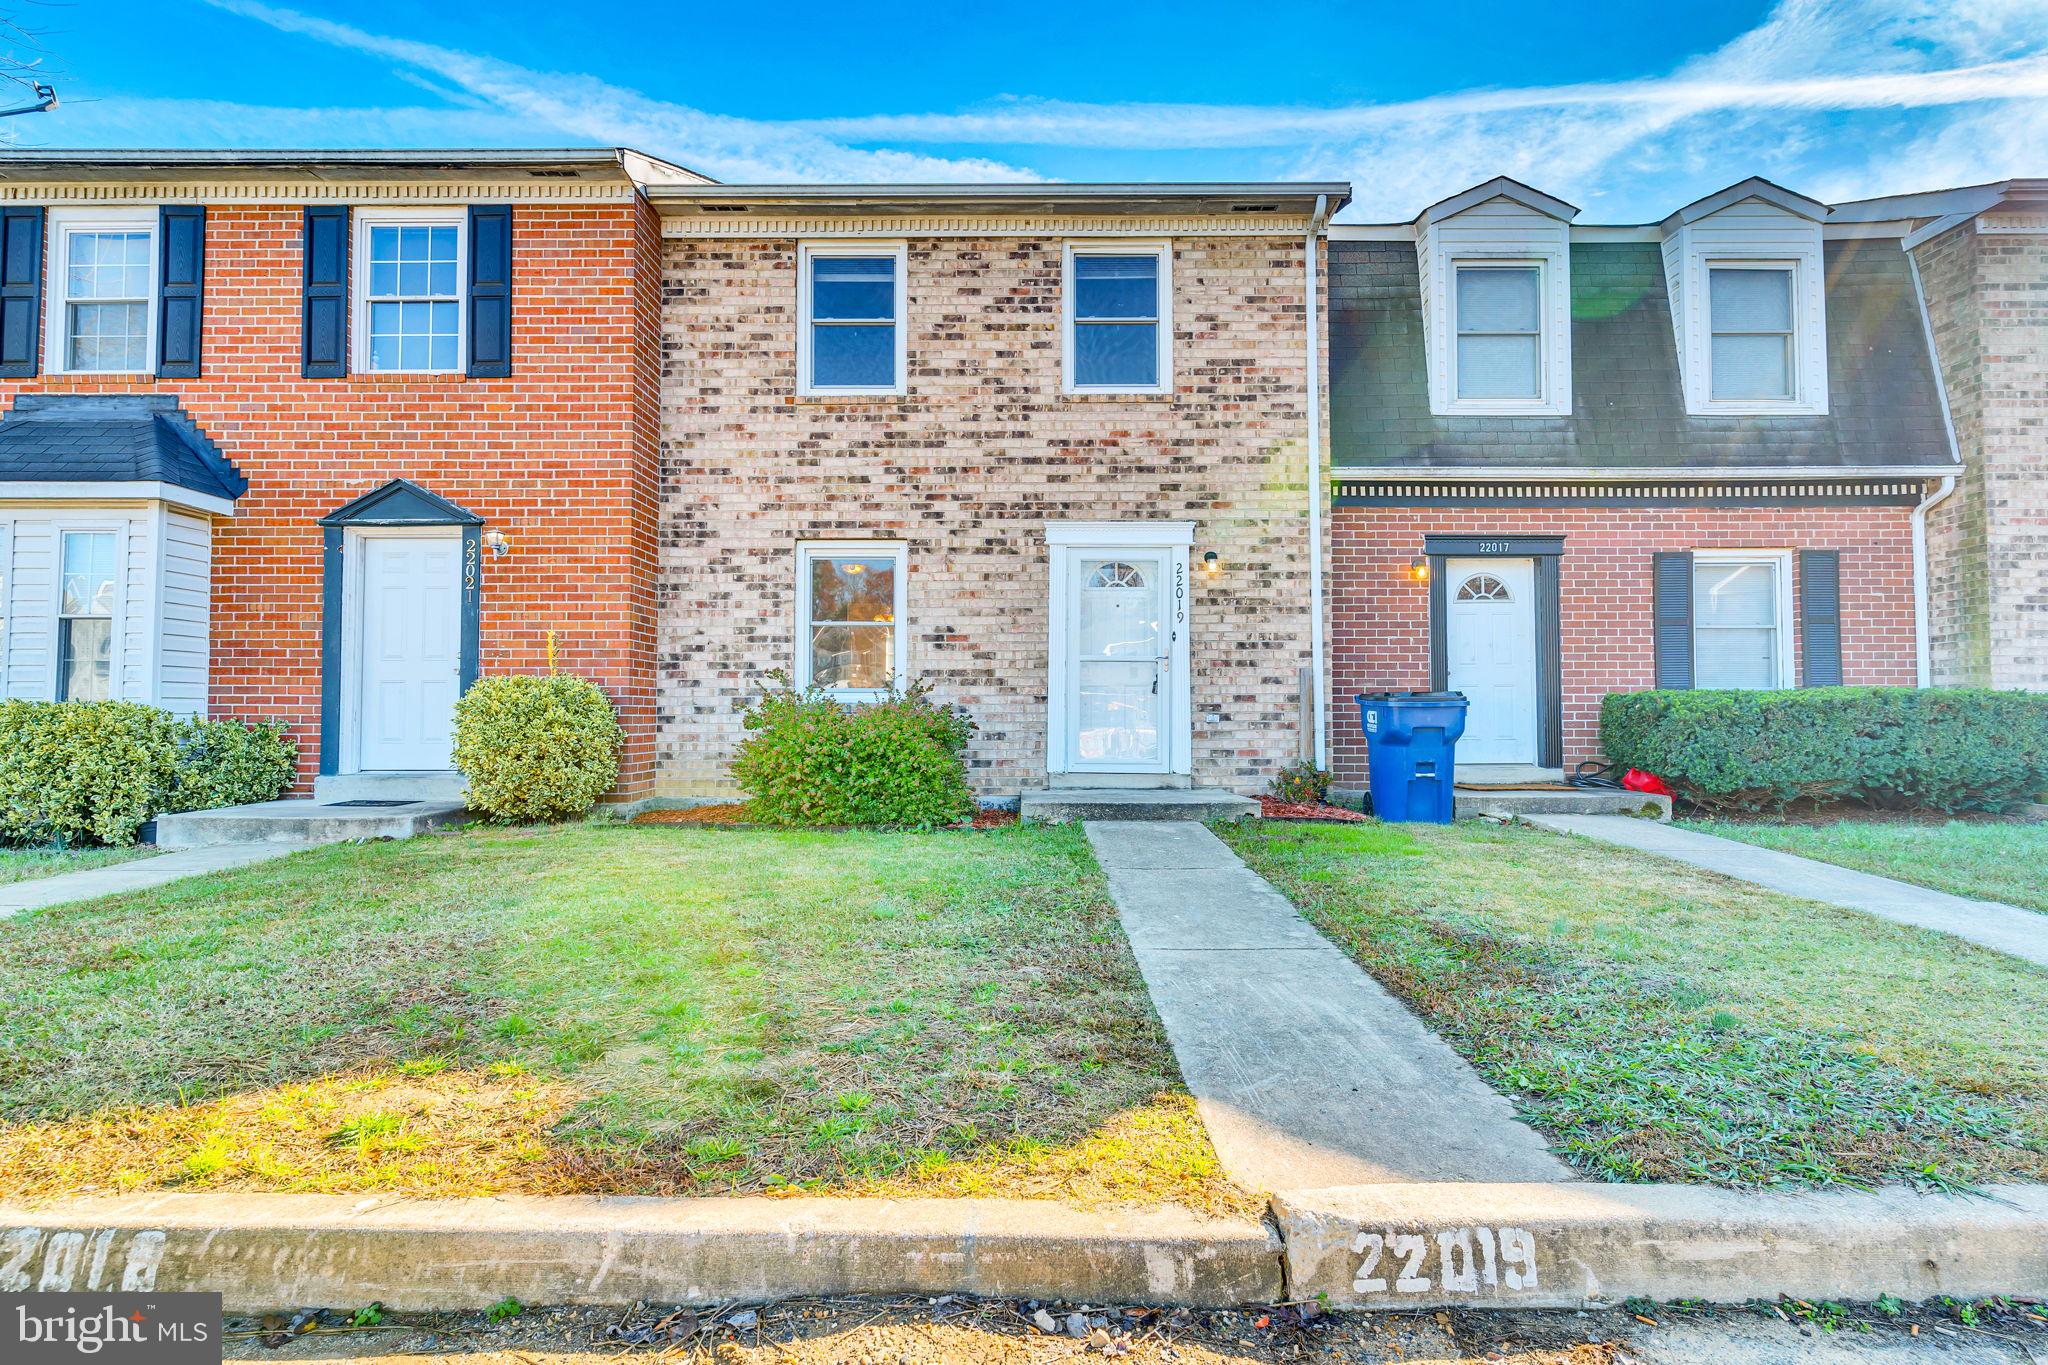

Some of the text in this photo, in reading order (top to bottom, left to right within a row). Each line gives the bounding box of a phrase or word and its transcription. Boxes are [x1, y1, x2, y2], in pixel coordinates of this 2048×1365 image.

[464, 539, 477, 603] 22021
[1479, 542, 1510, 553] 22017
[1175, 562, 1184, 624] 22019
[1352, 1226, 1539, 1295] 22019
